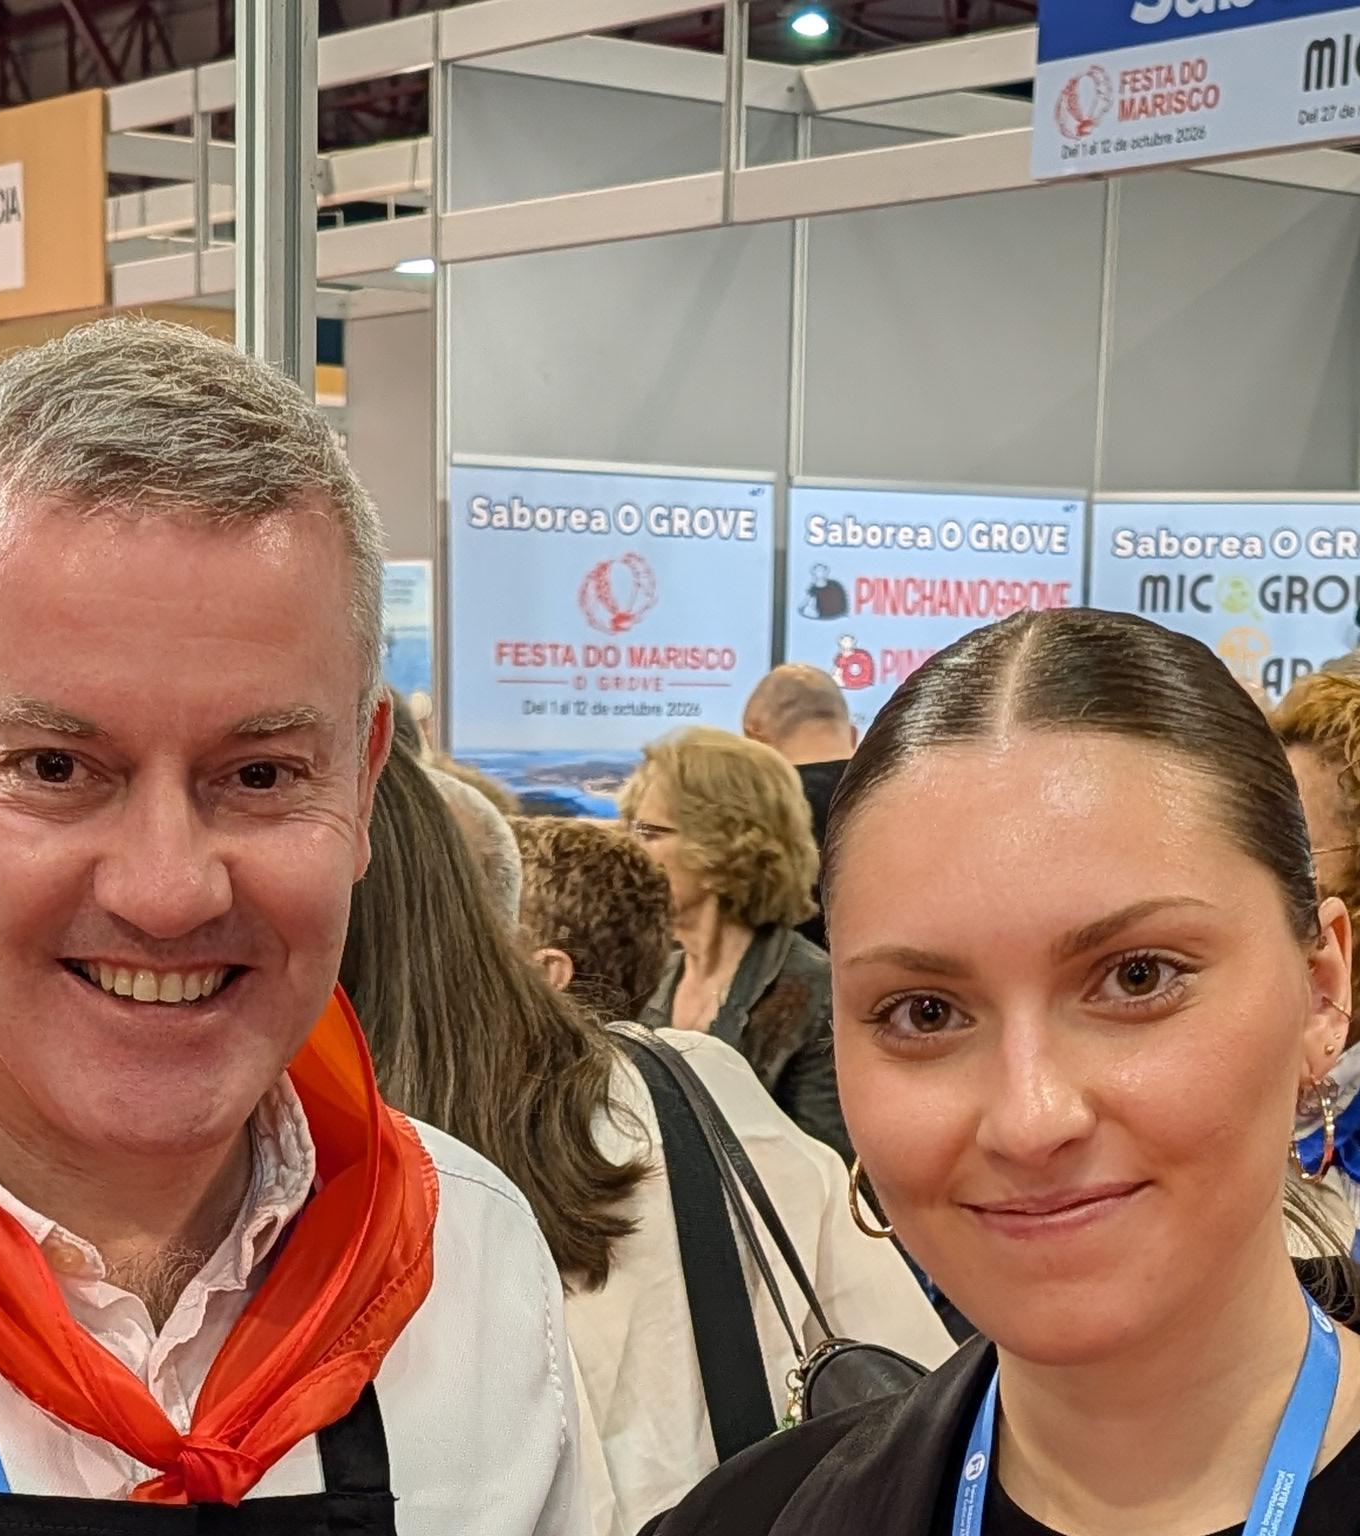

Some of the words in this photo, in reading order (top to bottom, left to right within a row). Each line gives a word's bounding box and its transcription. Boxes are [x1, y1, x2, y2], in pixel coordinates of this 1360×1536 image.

[1118, 63, 1177, 95] FESTA
[1179, 57, 1208, 86] DO
[1117, 84, 1221, 122] MARISCO
[1297, 109, 1319, 126] Del
[1320, 105, 1337, 122] 27
[1339, 103, 1356, 119] de
[1130, 133, 1173, 150] octubre
[1175, 125, 1207, 144] 2026
[469, 495, 611, 536] Saborea
[614, 501, 642, 536] O
[647, 504, 758, 542] GROVE
[805, 514, 934, 550] Saborea
[939, 519, 963, 551] O
[968, 521, 1070, 555] GROVE
[1112, 527, 1265, 559] Saborea
[1271, 529, 1301, 559] O
[495, 641, 578, 668] FESTA
[583, 645, 622, 669] DO
[627, 646, 738, 671] MARISCO
[572, 676, 588, 691] O
[597, 676, 664, 692] GROVE
[522, 700, 547, 716] Del
[572, 701, 588, 716] 12
[590, 701, 609, 716] de
[612, 701, 664, 717] octubre
[667, 702, 702, 717] 2026
